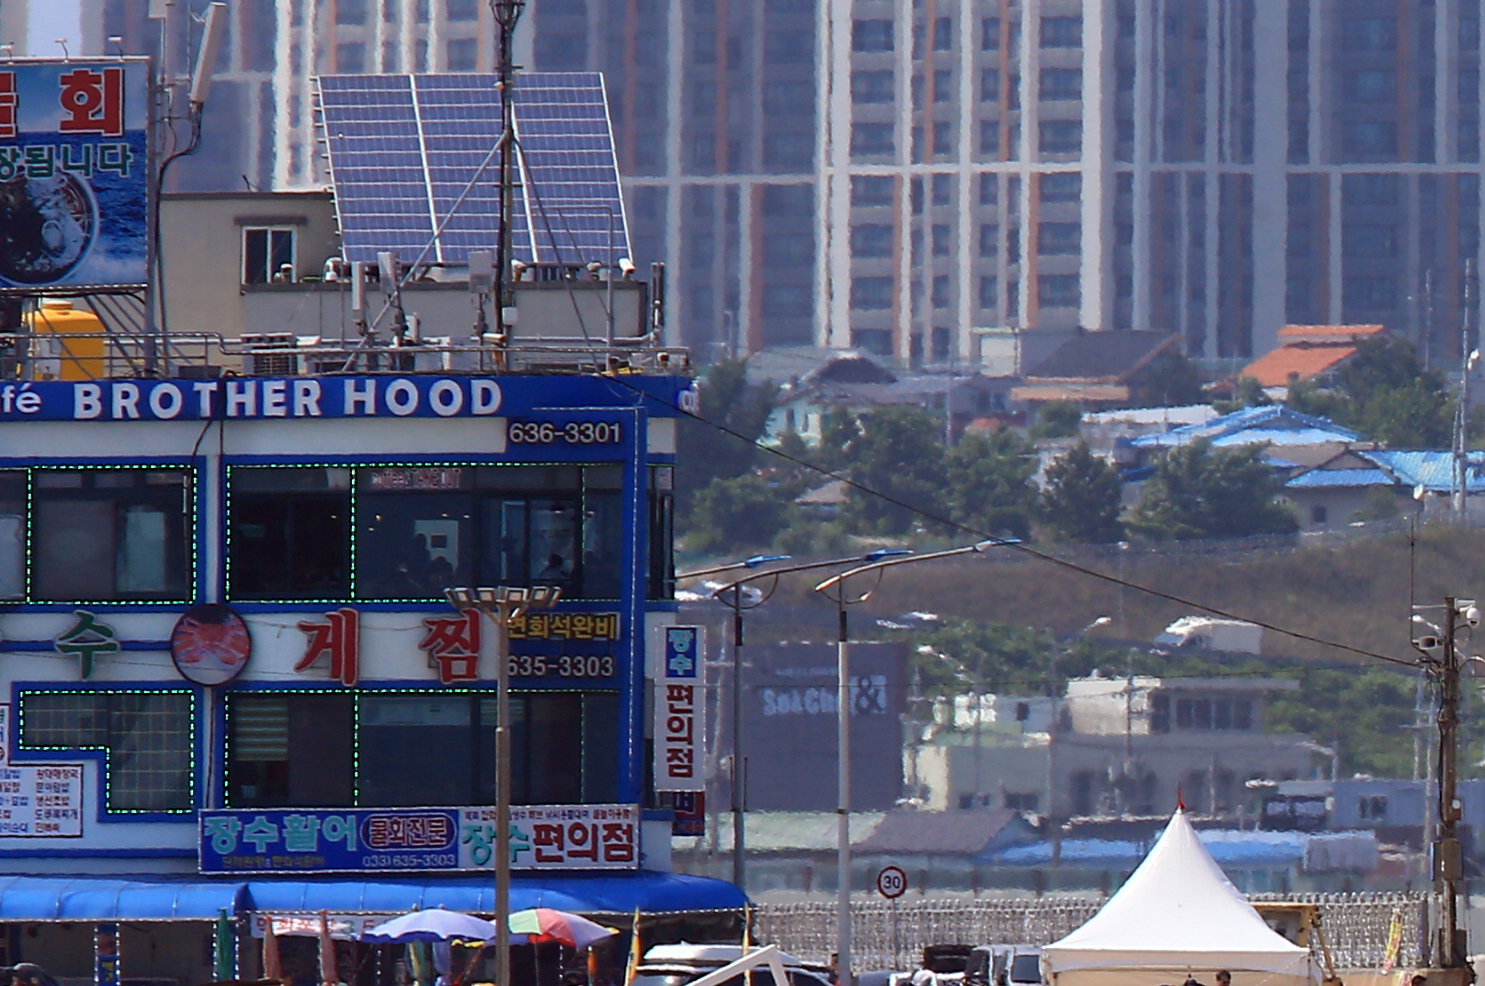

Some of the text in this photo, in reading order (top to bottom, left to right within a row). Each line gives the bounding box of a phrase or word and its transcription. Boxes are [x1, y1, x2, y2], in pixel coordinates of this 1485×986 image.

[0, 68, 124, 138] 회
[73, 380, 322, 420] BROTHER
[344, 378, 503, 416] HOOD
[509, 421, 622, 445] 636-3301
[507, 655, 614, 677] 635-3303
[668, 629, 694, 676] 장수
[666, 684, 694, 778] 편의점
[204, 813, 448, 855] 장수활어 물회전문
[883, 875, 901, 889] 30
